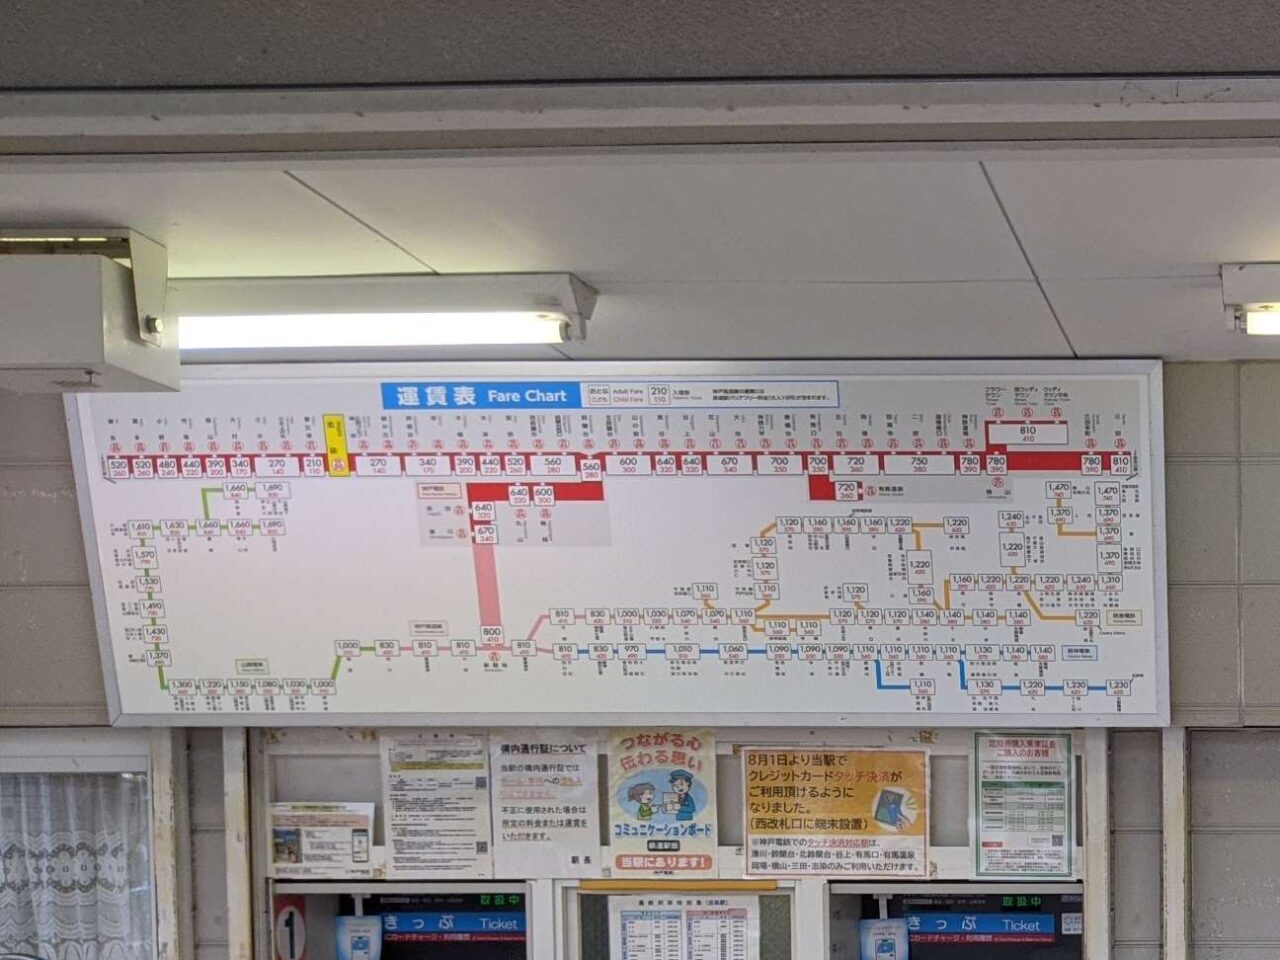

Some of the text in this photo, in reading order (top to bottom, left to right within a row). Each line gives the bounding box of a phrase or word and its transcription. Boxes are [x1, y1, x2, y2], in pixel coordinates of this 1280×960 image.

[651, 387, 667, 395] 210
[397, 386, 476, 406] 運賃表
[488, 390, 567, 402] Fare Chart
[111, 460, 127, 469] 520
[135, 460, 150, 469] 520
[159, 460, 175, 469] 480
[183, 460, 200, 469] 440
[208, 460, 224, 469] 390
[232, 460, 248, 469] 340
[269, 460, 285, 469] 270
[307, 459, 321, 467] 210
[370, 458, 386, 466] 270
[419, 458, 436, 466] 340
[457, 458, 473, 466] 390
[482, 458, 499, 466] 440
[507, 458, 524, 466] 520
[544, 458, 561, 466] 560
[620, 458, 637, 466] 600
[657, 458, 674, 466] 640
[683, 458, 700, 466] 640
[721, 458, 738, 466] 670
[771, 458, 788, 466] 700
[810, 457, 827, 465] 700
[847, 457, 864, 465] 720
[911, 457, 928, 465] 750
[962, 457, 978, 465] 780
[989, 457, 1005, 465] 780
[1083, 457, 1100, 465] 780
[1113, 457, 1128, 465] 810
[583, 463, 599, 471] 560
[510, 488, 527, 496] 640
[535, 488, 552, 496] 600
[620, 734, 701, 750] つながる心
[501, 744, 587, 753] 構内通行証について
[621, 750, 701, 771] 伝わる思い
[749, 754, 847, 766] 8月1日より当駅で
[749, 771, 902, 782] クレジットカードタッチ決済が
[749, 786, 854, 798] ご利用頂けるように
[750, 803, 811, 814] なりました。
[615, 824, 711, 836] コミュニケーションボード
[384, 914, 454, 930] きっぷ
[479, 918, 517, 930] Ticket
[908, 915, 977, 930] きっぷ
[1002, 919, 1040, 931] Ticket
